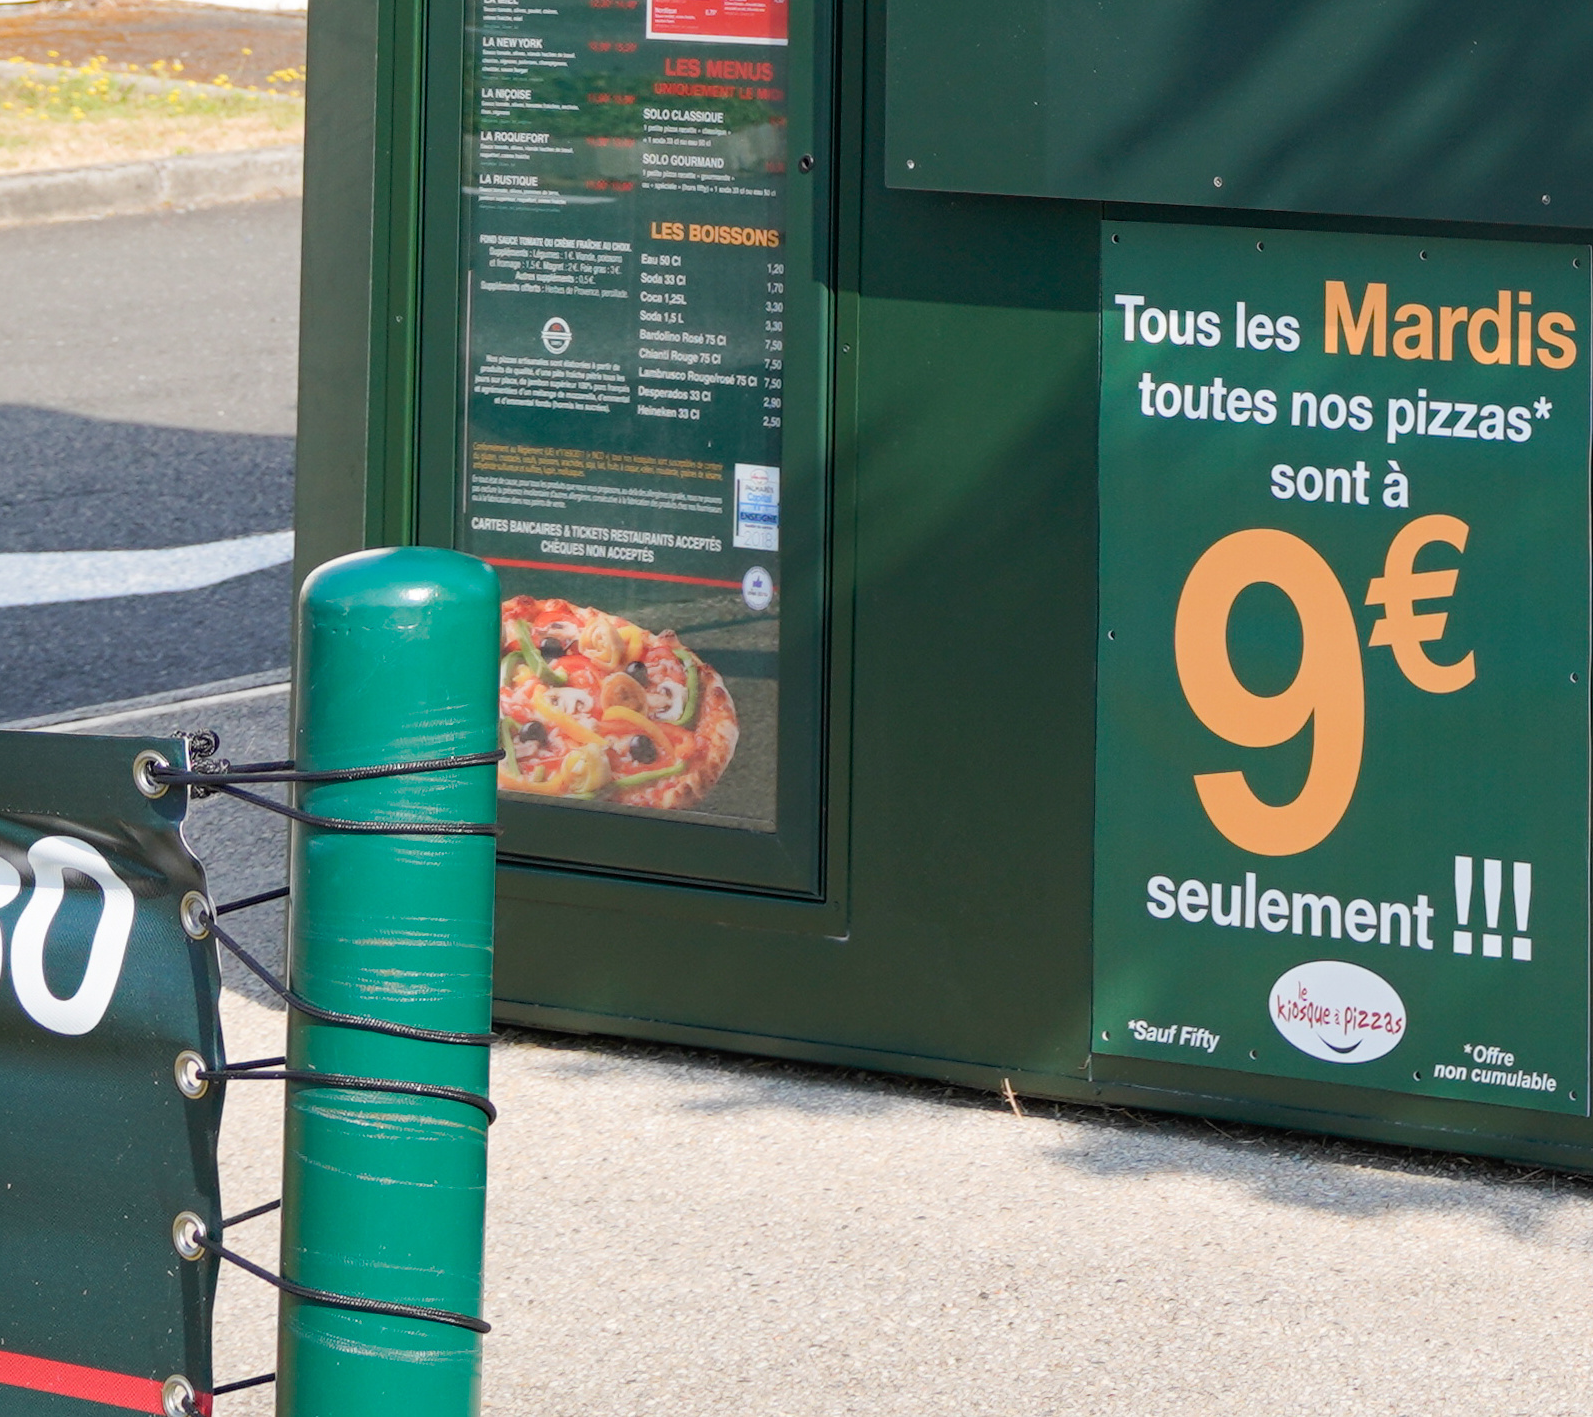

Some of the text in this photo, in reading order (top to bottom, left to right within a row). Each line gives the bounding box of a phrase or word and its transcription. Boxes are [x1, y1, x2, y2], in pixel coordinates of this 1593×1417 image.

[664, 58, 774, 81] LES MENUS
[643, 108, 724, 124] SOLO CLASSIQUE
[642, 153, 724, 168] SOLO GOURMAND
[651, 222, 780, 248] LES BOISSONS
[1115, 280, 1578, 370] Tous les Mardis
[1138, 372, 1278, 426] toutes
[1291, 390, 1373, 432] nos
[1270, 460, 1410, 508] sont à
[471, 518, 722, 552] CARTES BANCAIRES & TICKETS RESTAURANTS ACCEPTÉS
[585, 542, 607, 558] NON
[607, 543, 655, 563] ACCEPTÉS
[1147, 855, 1532, 962] seulement !!!
[1298, 981, 1308, 1001] le
[1276, 994, 1403, 1036] kiosque à pizzas
[1181, 1025, 1221, 1052] Fifty
[1433, 1062, 1557, 1092] non cumulable
